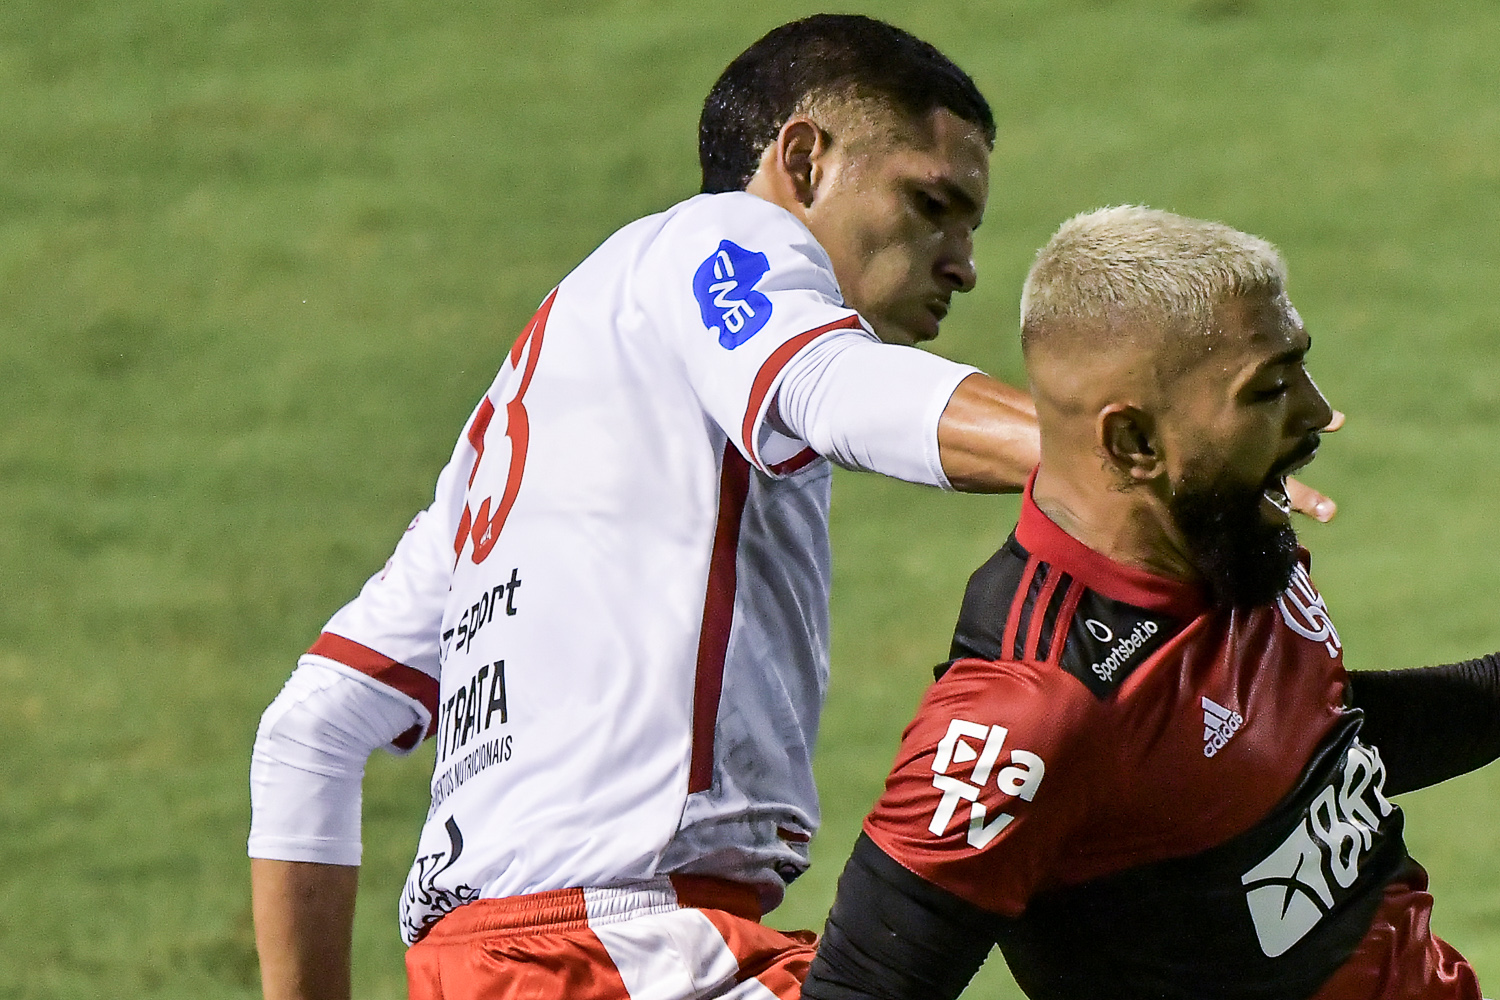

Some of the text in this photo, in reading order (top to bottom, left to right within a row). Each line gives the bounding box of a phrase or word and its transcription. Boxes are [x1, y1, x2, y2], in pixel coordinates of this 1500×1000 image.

[1092, 620, 1159, 682] Sportsbet.io
[931, 718, 1046, 803] Fla
[1203, 711, 1243, 758] adidas
